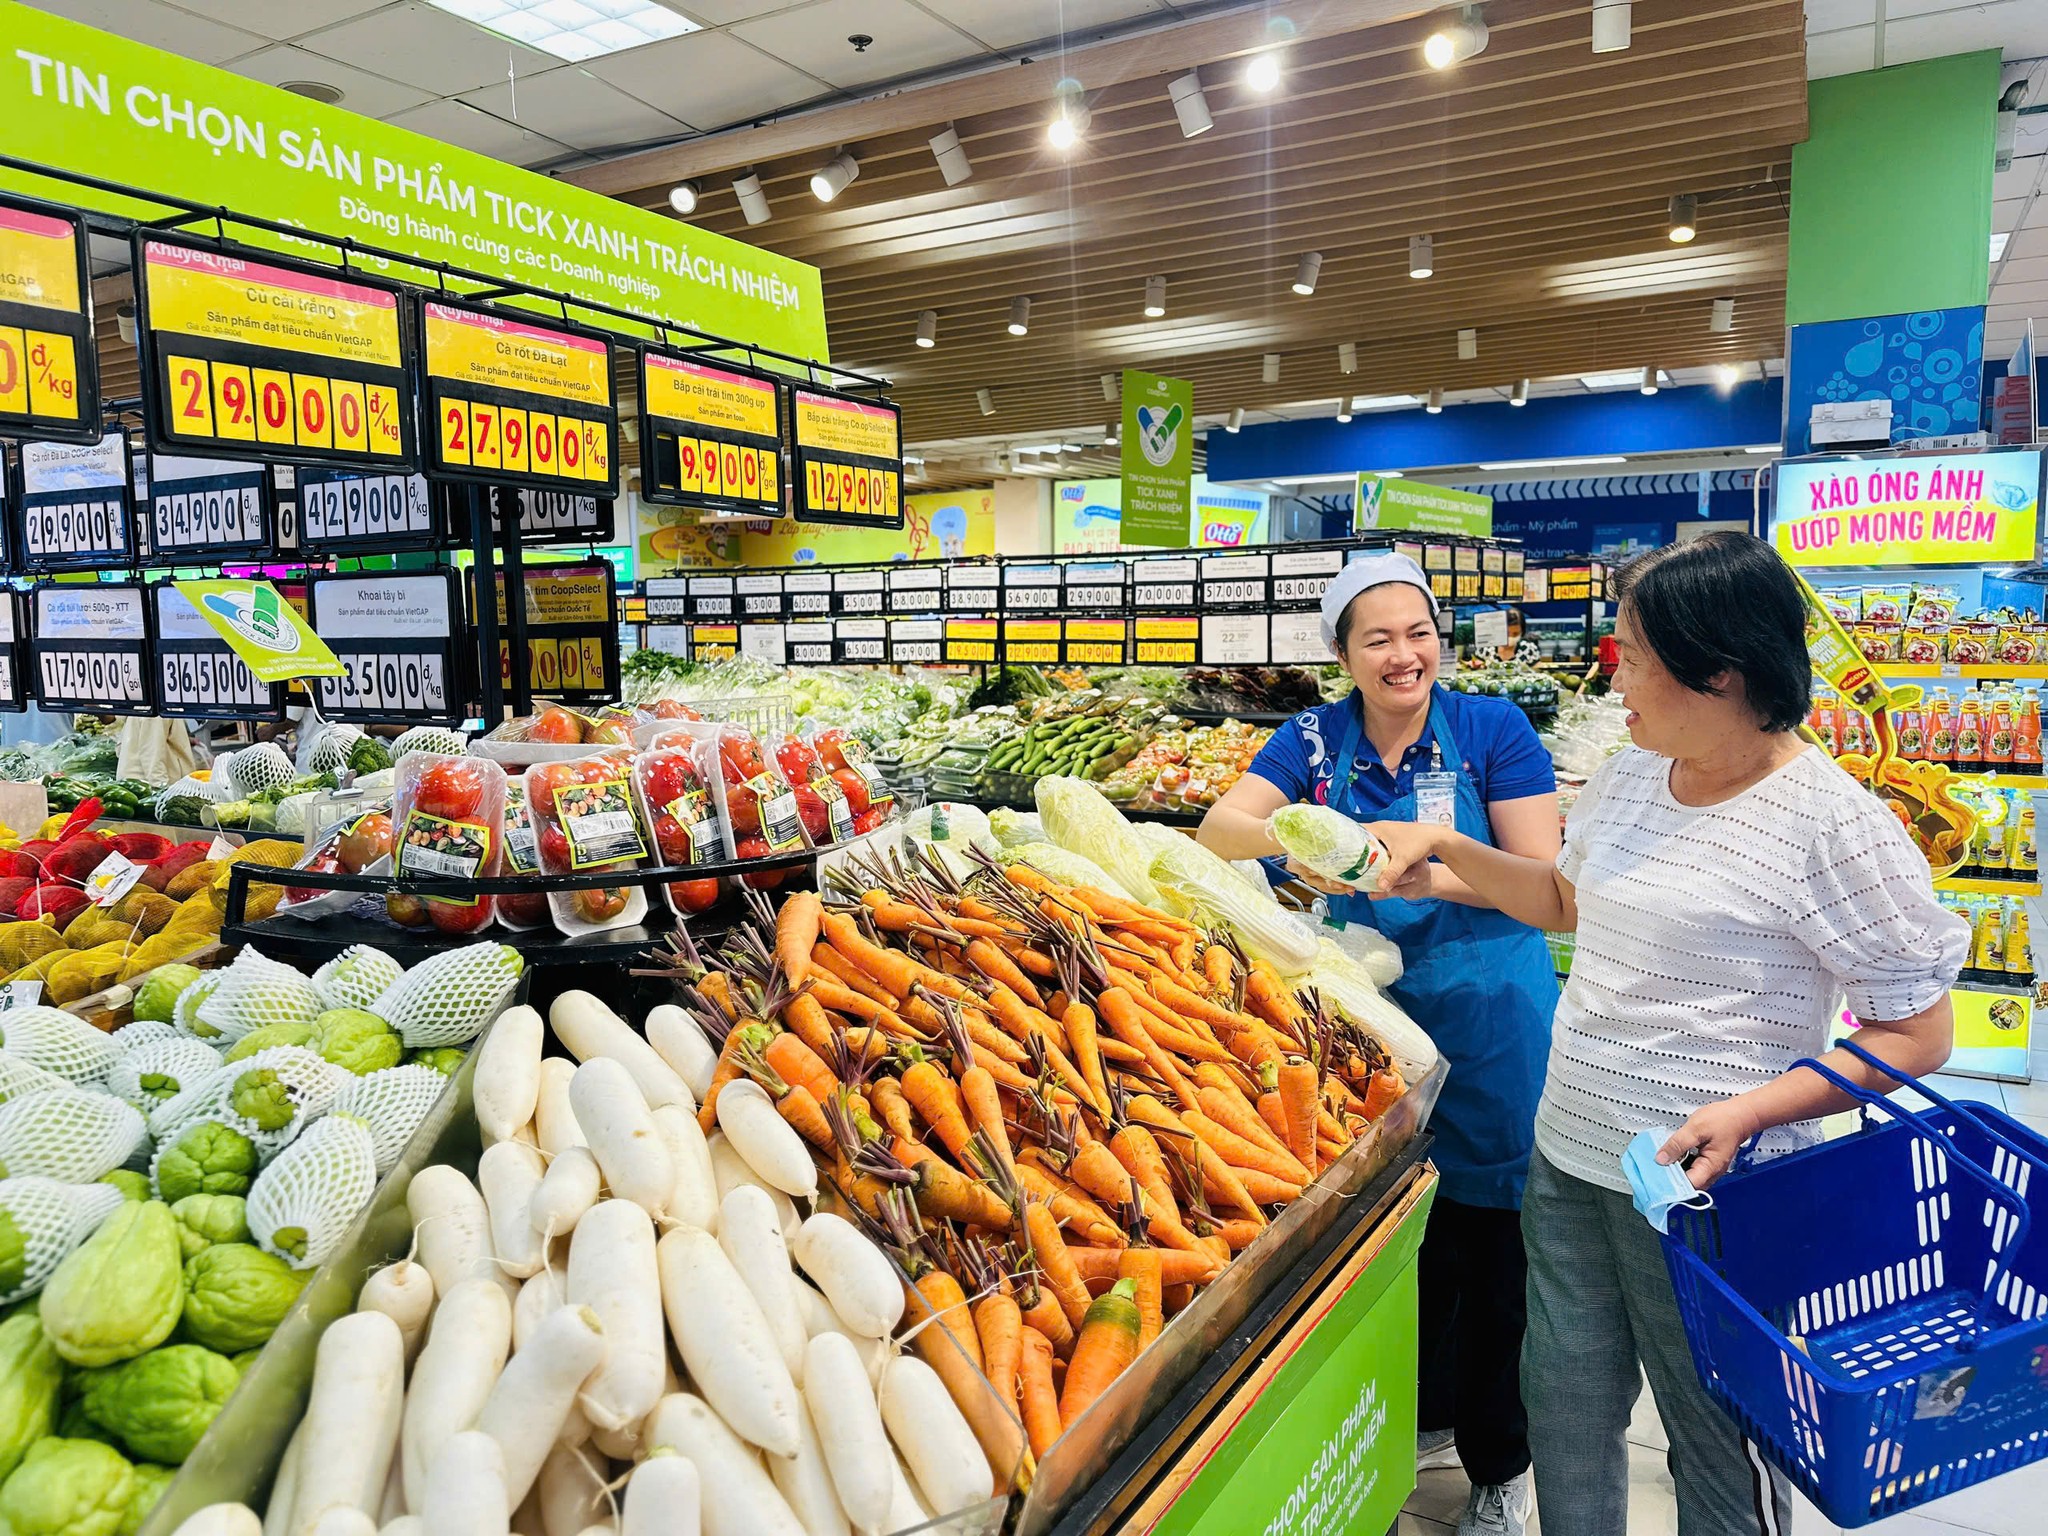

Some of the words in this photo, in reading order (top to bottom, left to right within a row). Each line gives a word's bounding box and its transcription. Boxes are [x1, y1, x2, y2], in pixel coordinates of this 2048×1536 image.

[16, 49, 111, 116] TIN
[125, 85, 267, 160] CHỌN
[279, 127, 363, 187] SẢN
[374, 156, 477, 219] PHẨM
[484, 190, 557, 241] TICK
[561, 214, 640, 265] XANH
[644, 239, 725, 286] TRÁCH
[732, 267, 800, 311] NHIỆM
[339, 196, 400, 237] Đồng
[405, 213, 457, 247] hành
[462, 232, 510, 264] cùng
[515, 246, 546, 269] các
[550, 253, 604, 284] Doanh
[607, 271, 661, 301] nghiệp
[246, 288, 267, 304] Củ
[272, 291, 294, 309] cải
[208, 311, 228, 324] Sản
[231, 316, 260, 329] phẩm
[263, 321, 280, 334] đạt
[282, 325, 301, 336] tiêu
[303, 327, 333, 341] chuẩn
[335, 332, 373, 348] VietGAP
[496, 341, 511, 354] Cà
[515, 345, 530, 360] rốt
[533, 348, 548, 363] Đà
[470, 362, 486, 374] Sản
[488, 367, 508, 380] phẩm
[511, 370, 523, 381] đạt
[525, 373, 538, 384] tiêu
[540, 375, 562, 388] chuẩn
[562, 380, 591, 392] VietGAP
[673, 379, 690, 395] Bắp
[692, 383, 705, 396] cải
[706, 386, 720, 399] trái
[721, 391, 734, 402] tim
[736, 393, 754, 408] 300g
[180, 369, 360, 438] 29.000
[447, 408, 579, 468] 27.900
[681, 445, 756, 486] 9.900
[811, 469, 882, 506] 12.900
[1136, 486, 1154, 497] TICK
[1156, 488, 1178, 499] XANH
[1809, 473, 1860, 511] XÀO
[1868, 466, 1919, 504] ÓNG
[1927, 463, 1985, 501] ÁNH
[308, 484, 401, 527] 42.900
[1130, 498, 1156, 511] TRÁCH
[159, 496, 235, 536] 34.900
[29, 511, 104, 546] 29.900
[1205, 522, 1240, 544] Otto
[1528, 521, 1545, 533] Mỹ
[1547, 518, 1578, 532] phẩm
[1791, 513, 1840, 552] ƯỚP
[1849, 510, 1923, 547] MỌNG
[535, 585, 549, 595] tim
[550, 584, 601, 597] CoopSelect
[1138, 588, 1182, 601] 70.000
[1206, 584, 1252, 598] 57.000
[1276, 581, 1326, 596] 48.000
[358, 590, 382, 601] Khoai
[383, 590, 395, 603] tây
[746, 598, 772, 610] 6.500
[793, 597, 822, 608] 6.500
[845, 596, 873, 608] 5.500
[894, 593, 930, 606] 68.000
[952, 592, 988, 604] 38.900
[1008, 591, 1048, 604] 56.900
[1070, 590, 1110, 603] 29.900
[92, 603, 110, 614] 500g
[116, 602, 130, 612] XTT
[338, 608, 350, 616] Sản
[350, 607, 366, 617] phẩm
[366, 607, 375, 616] đạt
[376, 607, 387, 616] tiêu
[388, 606, 404, 616] chuẩn
[405, 607, 429, 616] VietGAP
[548, 605, 566, 613] chuẩn
[566, 604, 582, 614] Quốc
[795, 648, 822, 658] 8.000
[846, 642, 875, 655] 6.500
[895, 644, 930, 657] 49.900
[1008, 646, 1048, 659] 22.900
[1070, 646, 1110, 659] 21.900
[45, 658, 120, 689] 17.900
[167, 661, 247, 692] 36.500
[1263, 1474, 1307, 1536] CHỌN
[1310, 1431, 1339, 1493] SẢN
[1341, 1377, 1376, 1449] PHẨM
[1300, 1459, 1346, 1536] TRÁCH
[1349, 1399, 1386, 1476] NHIỆM
